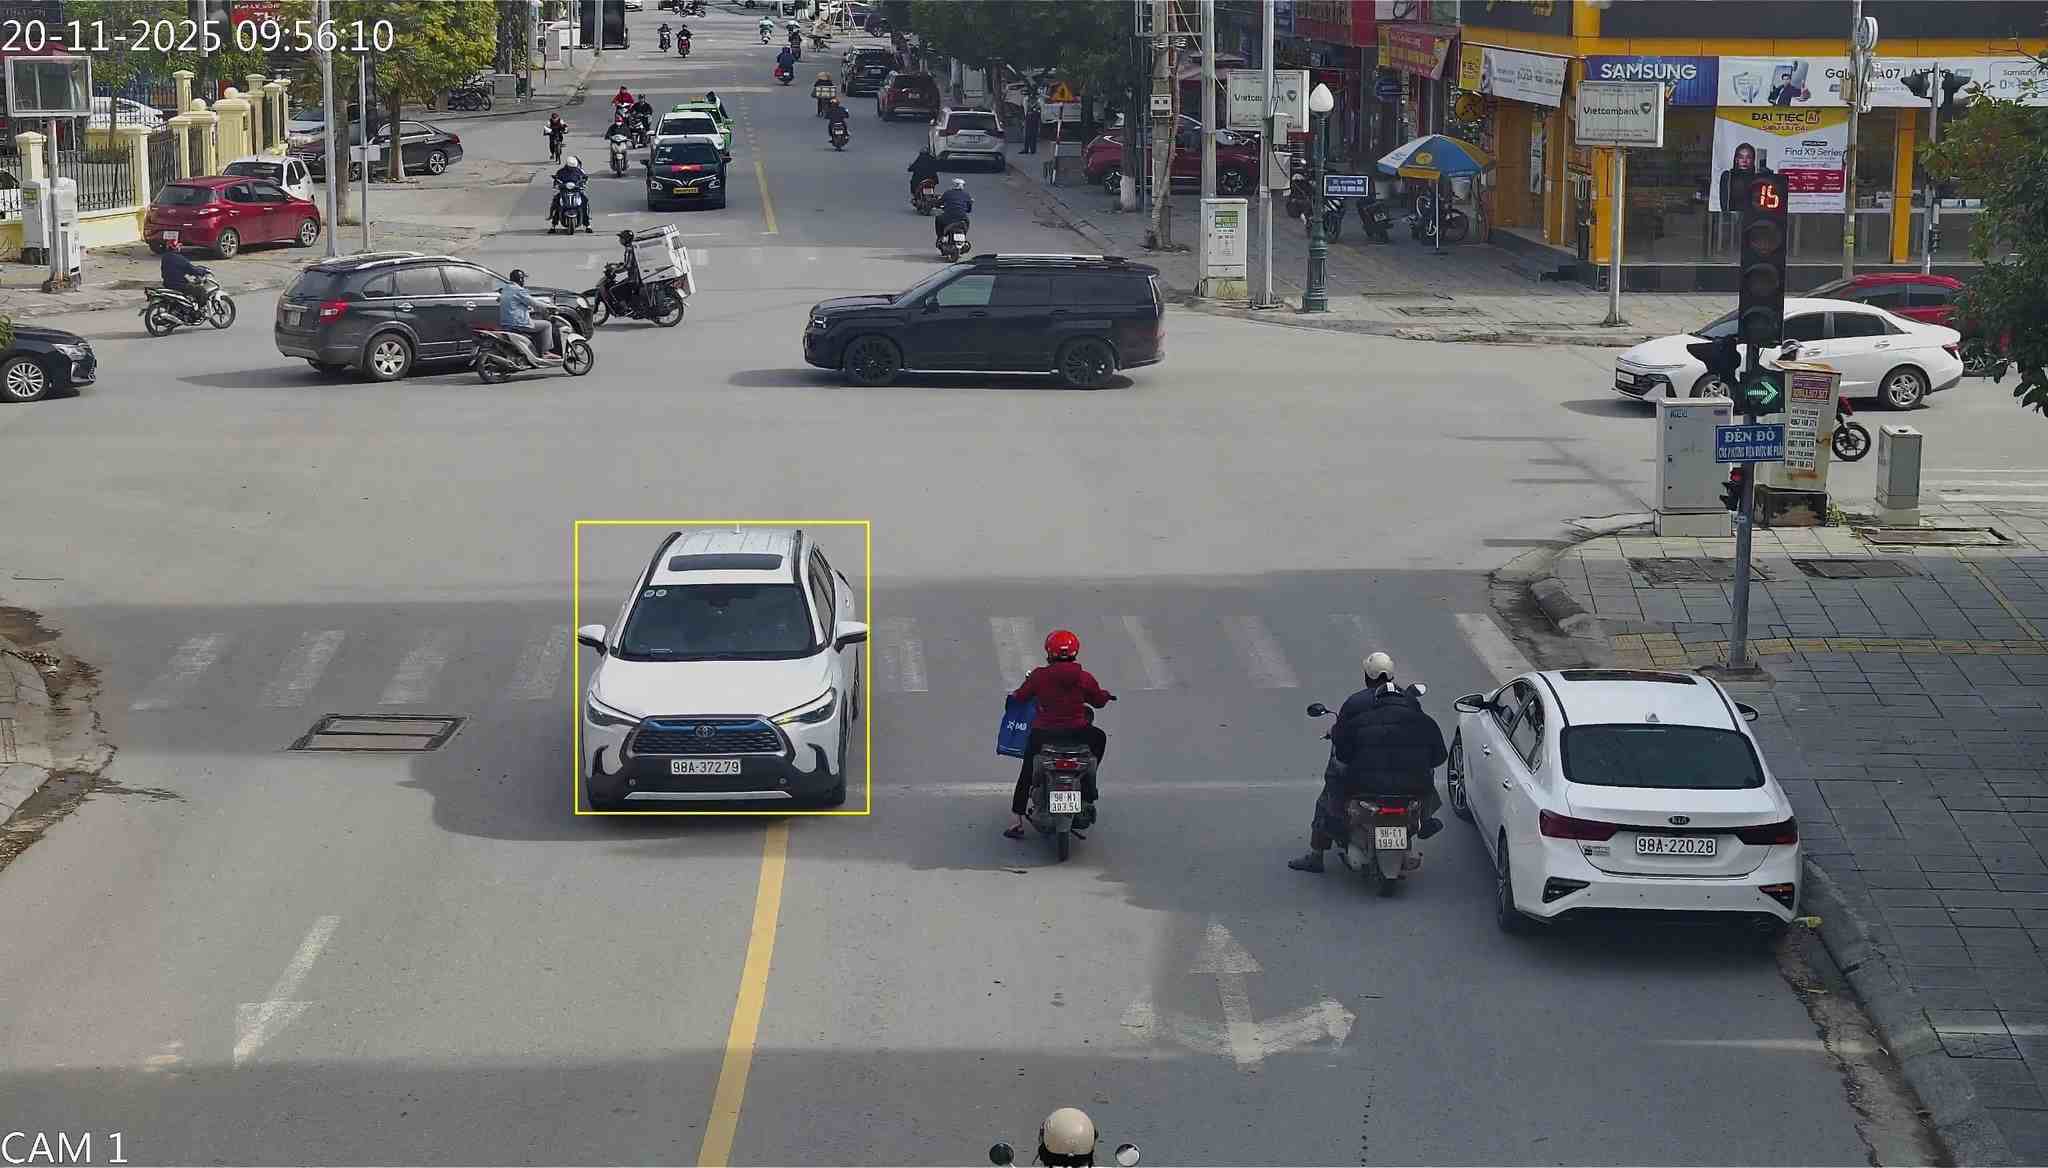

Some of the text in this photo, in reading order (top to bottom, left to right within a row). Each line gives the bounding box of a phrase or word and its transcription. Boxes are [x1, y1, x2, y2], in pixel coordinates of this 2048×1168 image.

[1601, 63, 1697, 80] SAMSUNG
[1584, 106, 1639, 116] Vietcombank
[1760, 185, 1779, 203] 15
